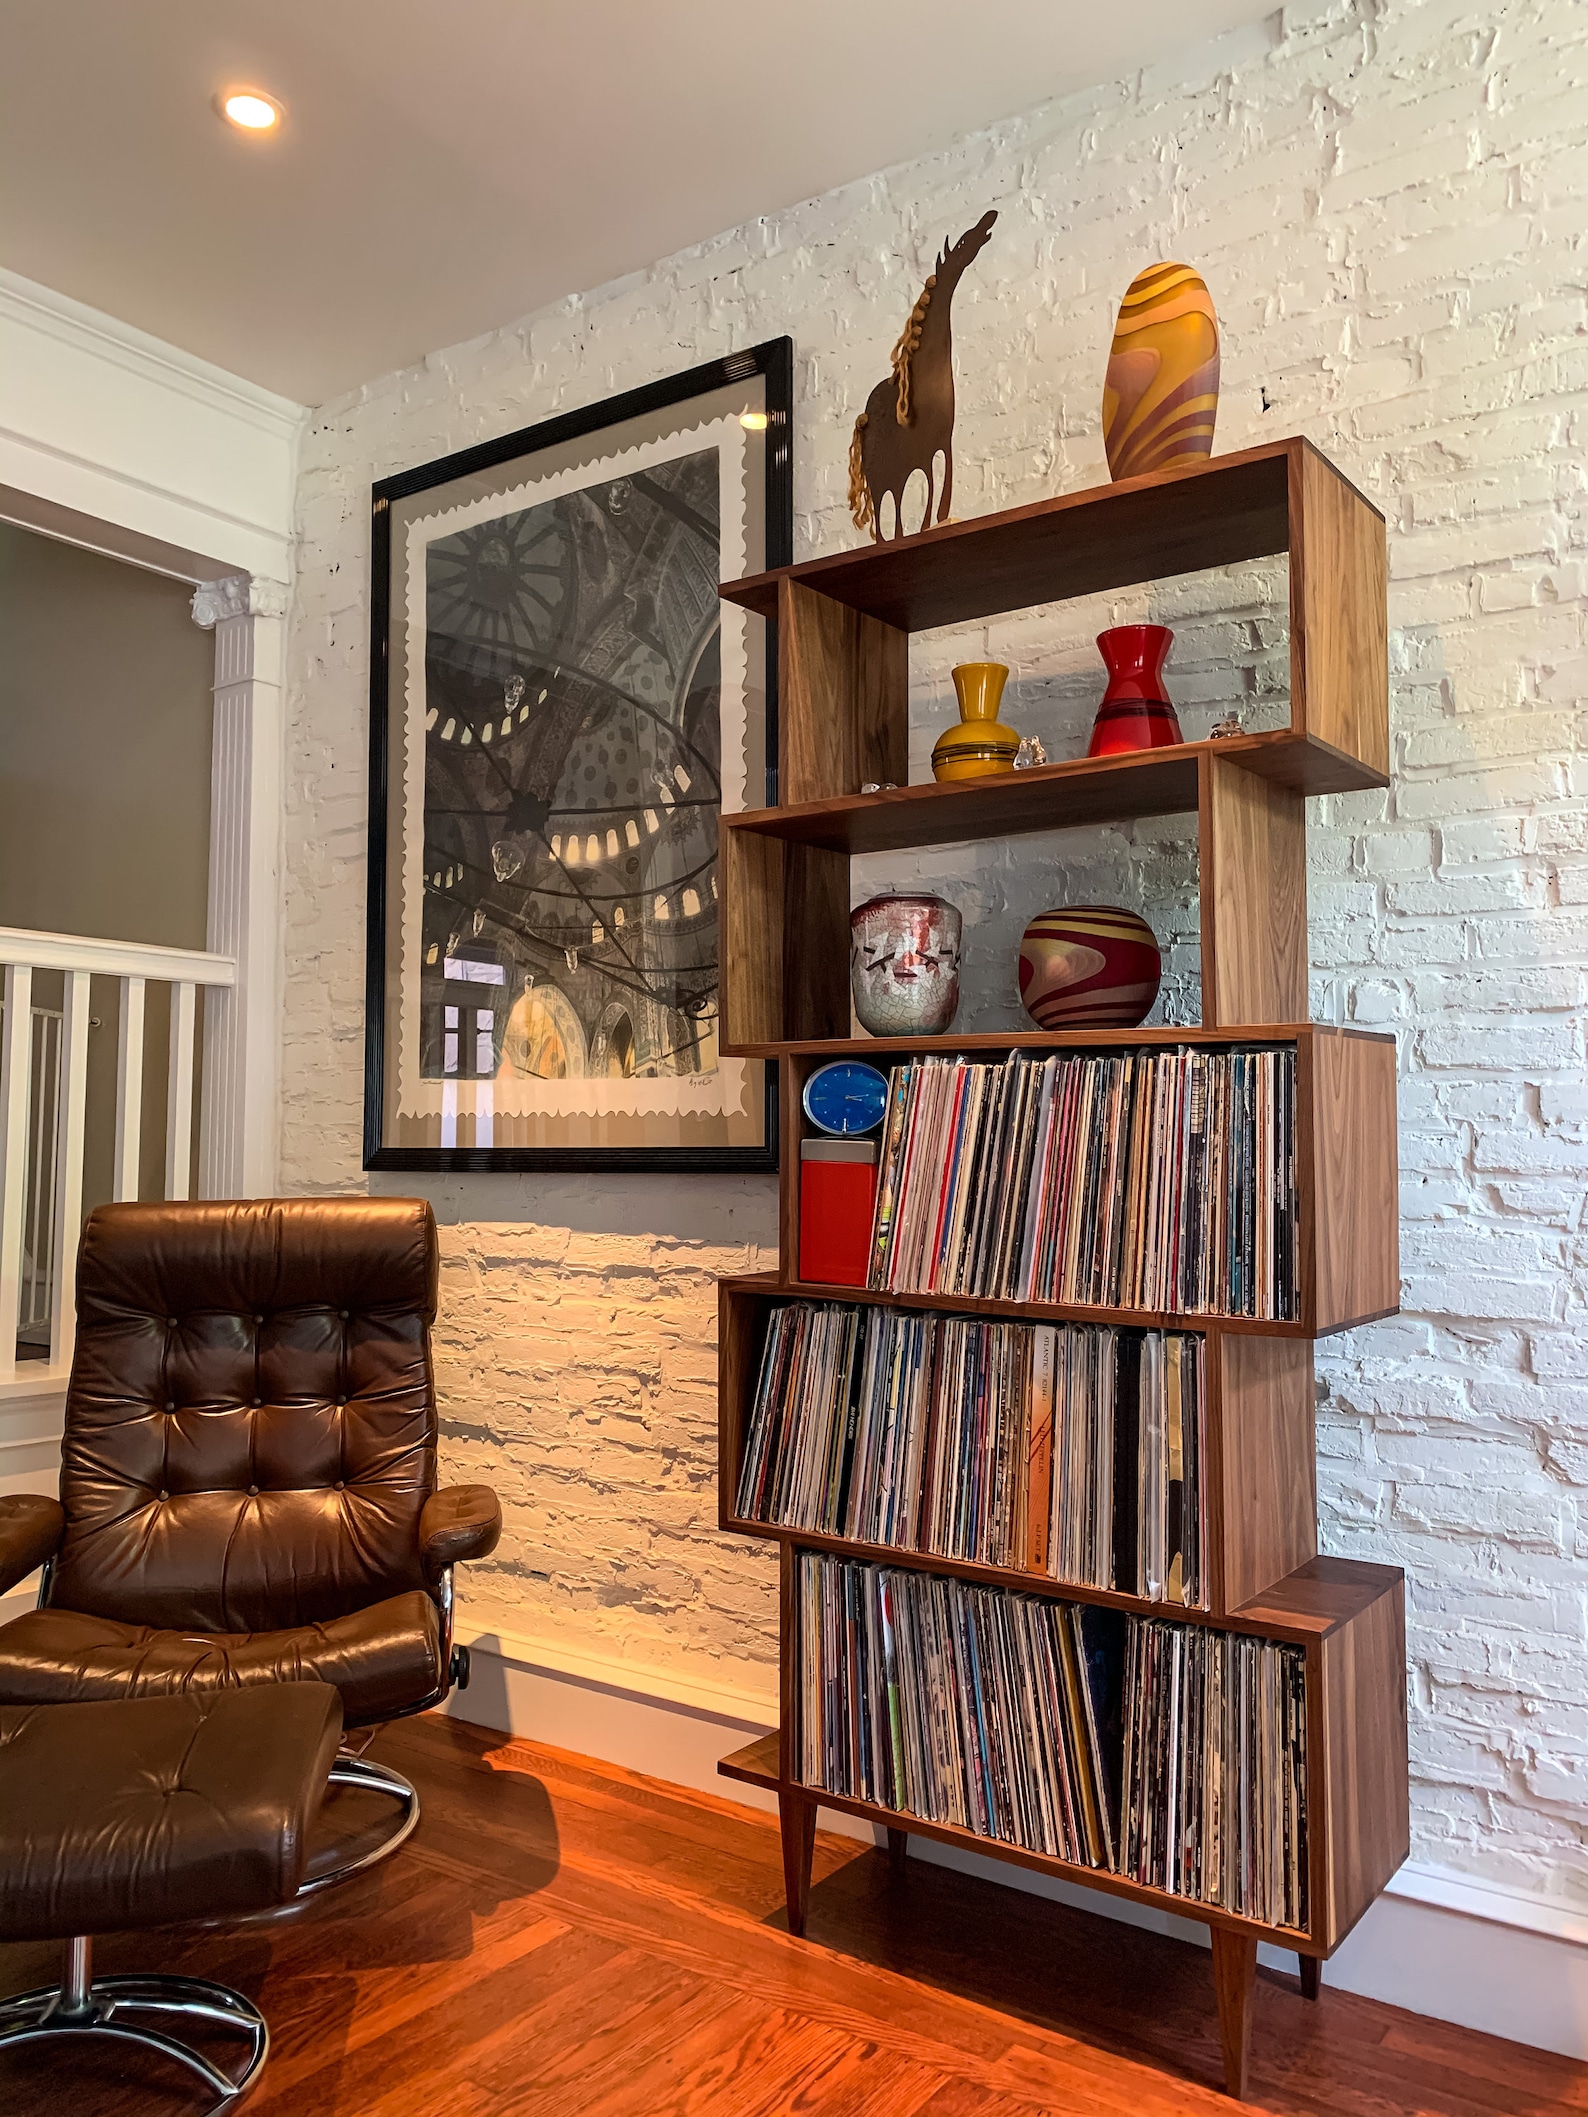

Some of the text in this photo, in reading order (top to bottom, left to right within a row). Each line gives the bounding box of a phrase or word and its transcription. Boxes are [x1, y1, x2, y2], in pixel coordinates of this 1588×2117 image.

[1042, 1335, 1050, 1370] ATLANTIC
[848, 1416, 856, 1440] HENDRIX
[1038, 1443, 1046, 1475] ZEPPELIN
